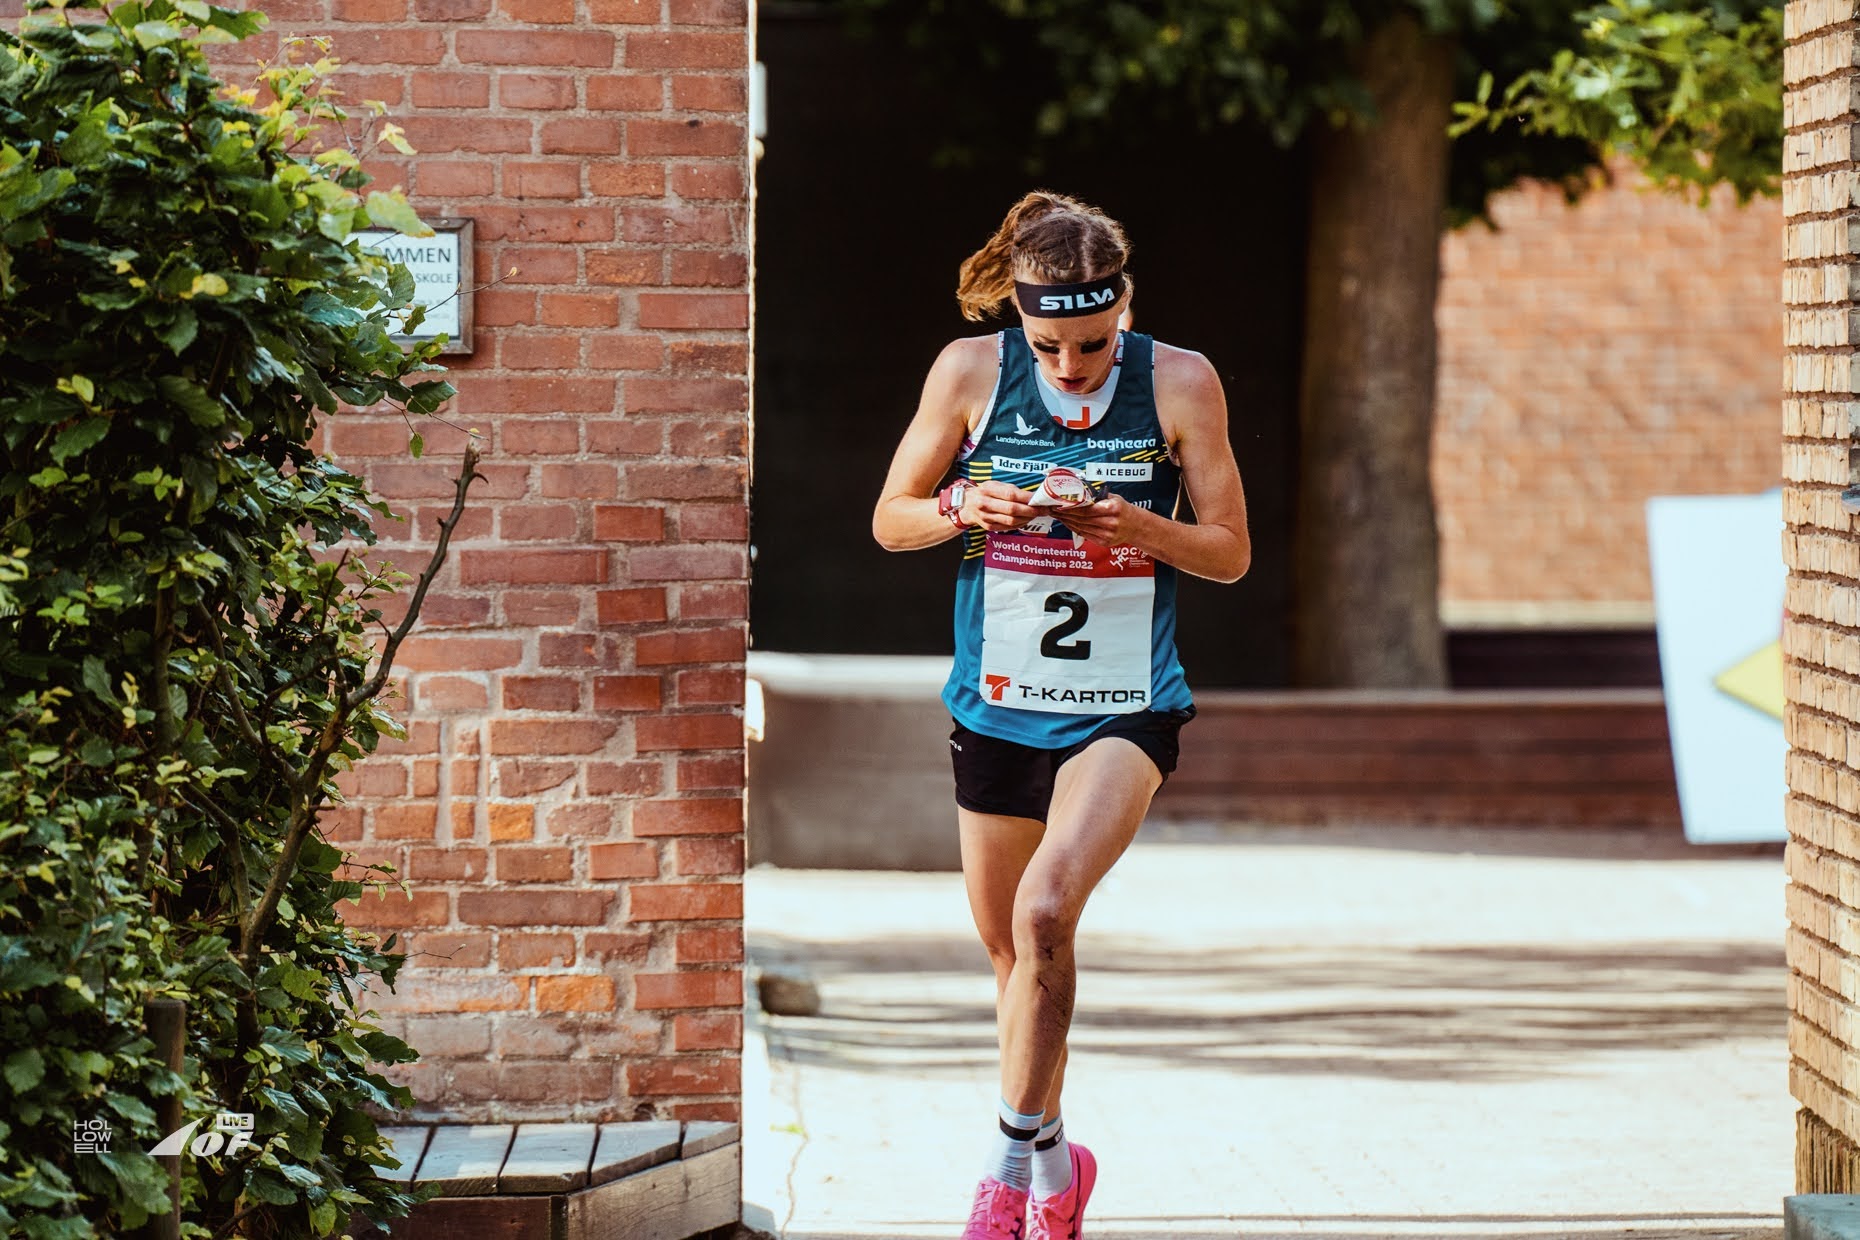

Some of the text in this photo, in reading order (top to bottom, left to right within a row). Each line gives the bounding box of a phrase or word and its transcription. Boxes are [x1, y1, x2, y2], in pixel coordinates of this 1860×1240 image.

[385, 247, 451, 263] MMEN
[415, 272, 453, 284] SKOLE
[1040, 287, 1115, 311] SILVA
[995, 434, 1056, 448] Landshypotek Bank
[1087, 437, 1157, 451] bagheera
[999, 458, 1021, 470] Idre
[1105, 468, 1146, 476] ICEBUG
[992, 540, 1087, 559] World Orienteering
[992, 552, 1094, 570] Championships 2022
[1040, 591, 1092, 660] 2
[1018, 684, 1146, 704] T-KARTOR
